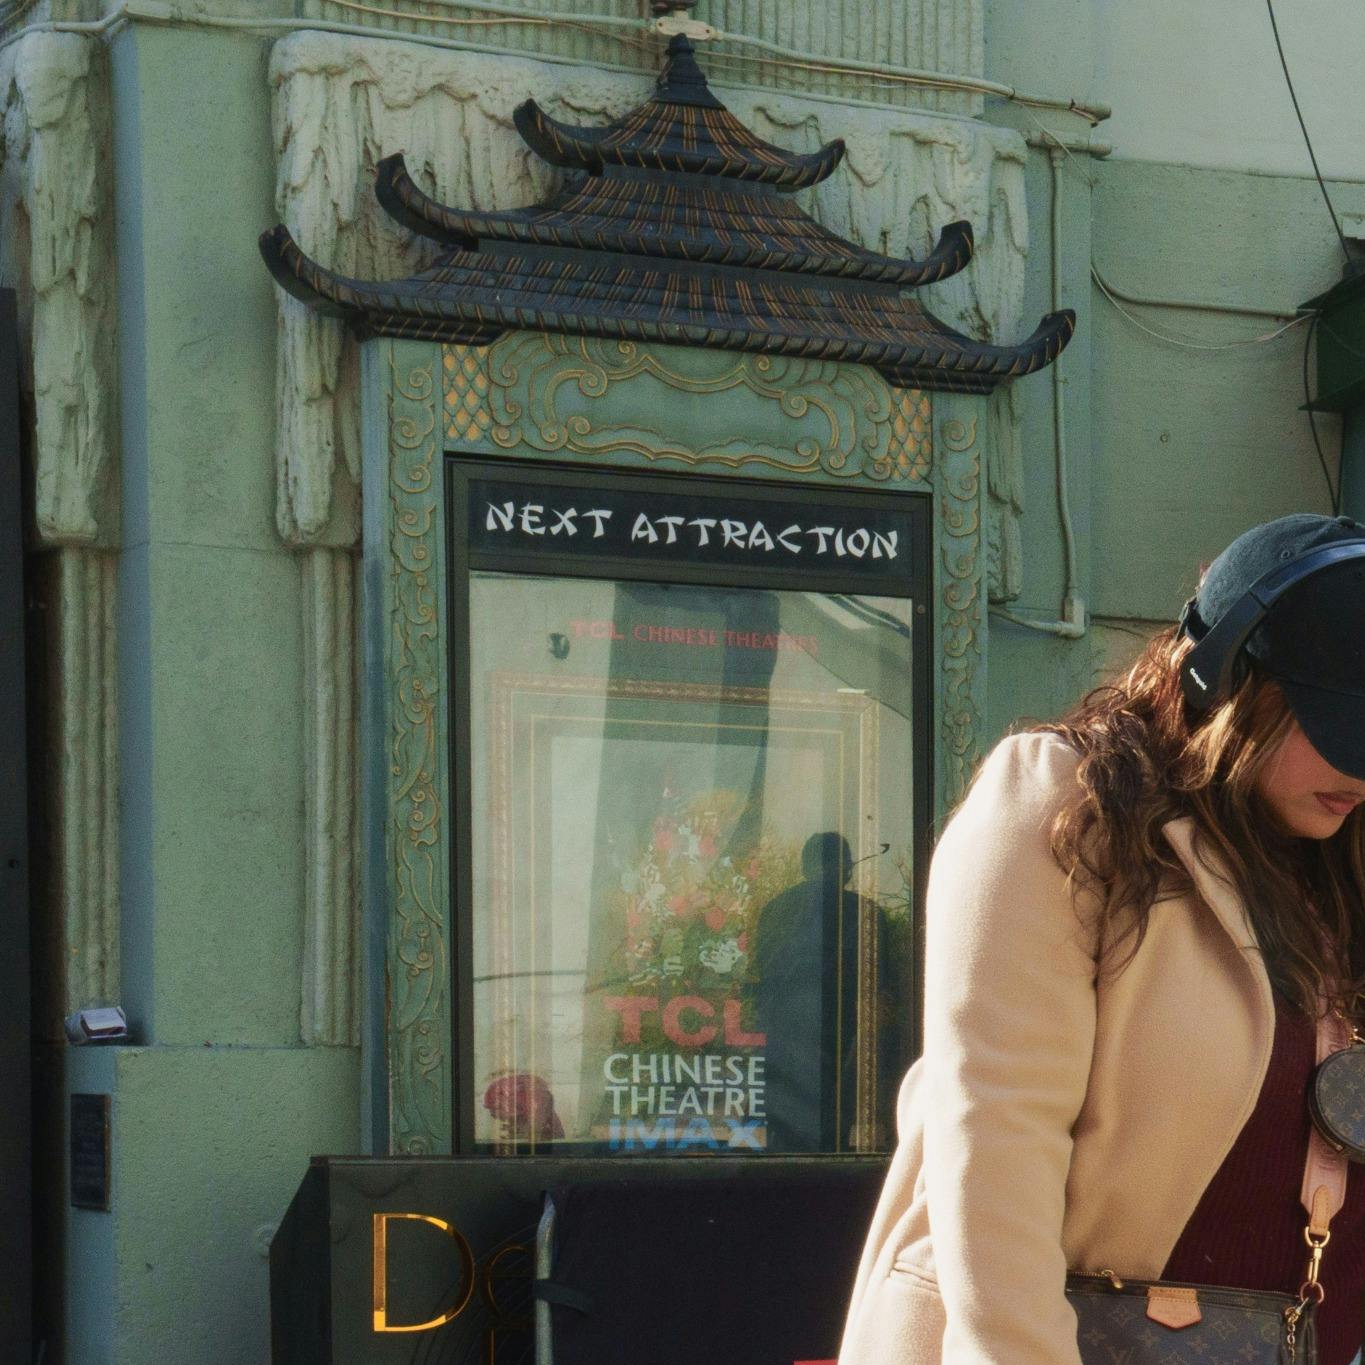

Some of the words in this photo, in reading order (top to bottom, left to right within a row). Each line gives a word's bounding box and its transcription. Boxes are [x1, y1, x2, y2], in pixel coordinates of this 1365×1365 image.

[485, 501, 612, 538] NEXT
[631, 512, 898, 561] ATTRACTION
[569, 618, 626, 640] TCL
[633, 624, 718, 647] CHINESE
[605, 996, 767, 1046] TCL
[604, 1053, 767, 1087] CHINESE
[605, 1086, 767, 1118] THEATRE
[608, 1118, 766, 1151] IMAX
